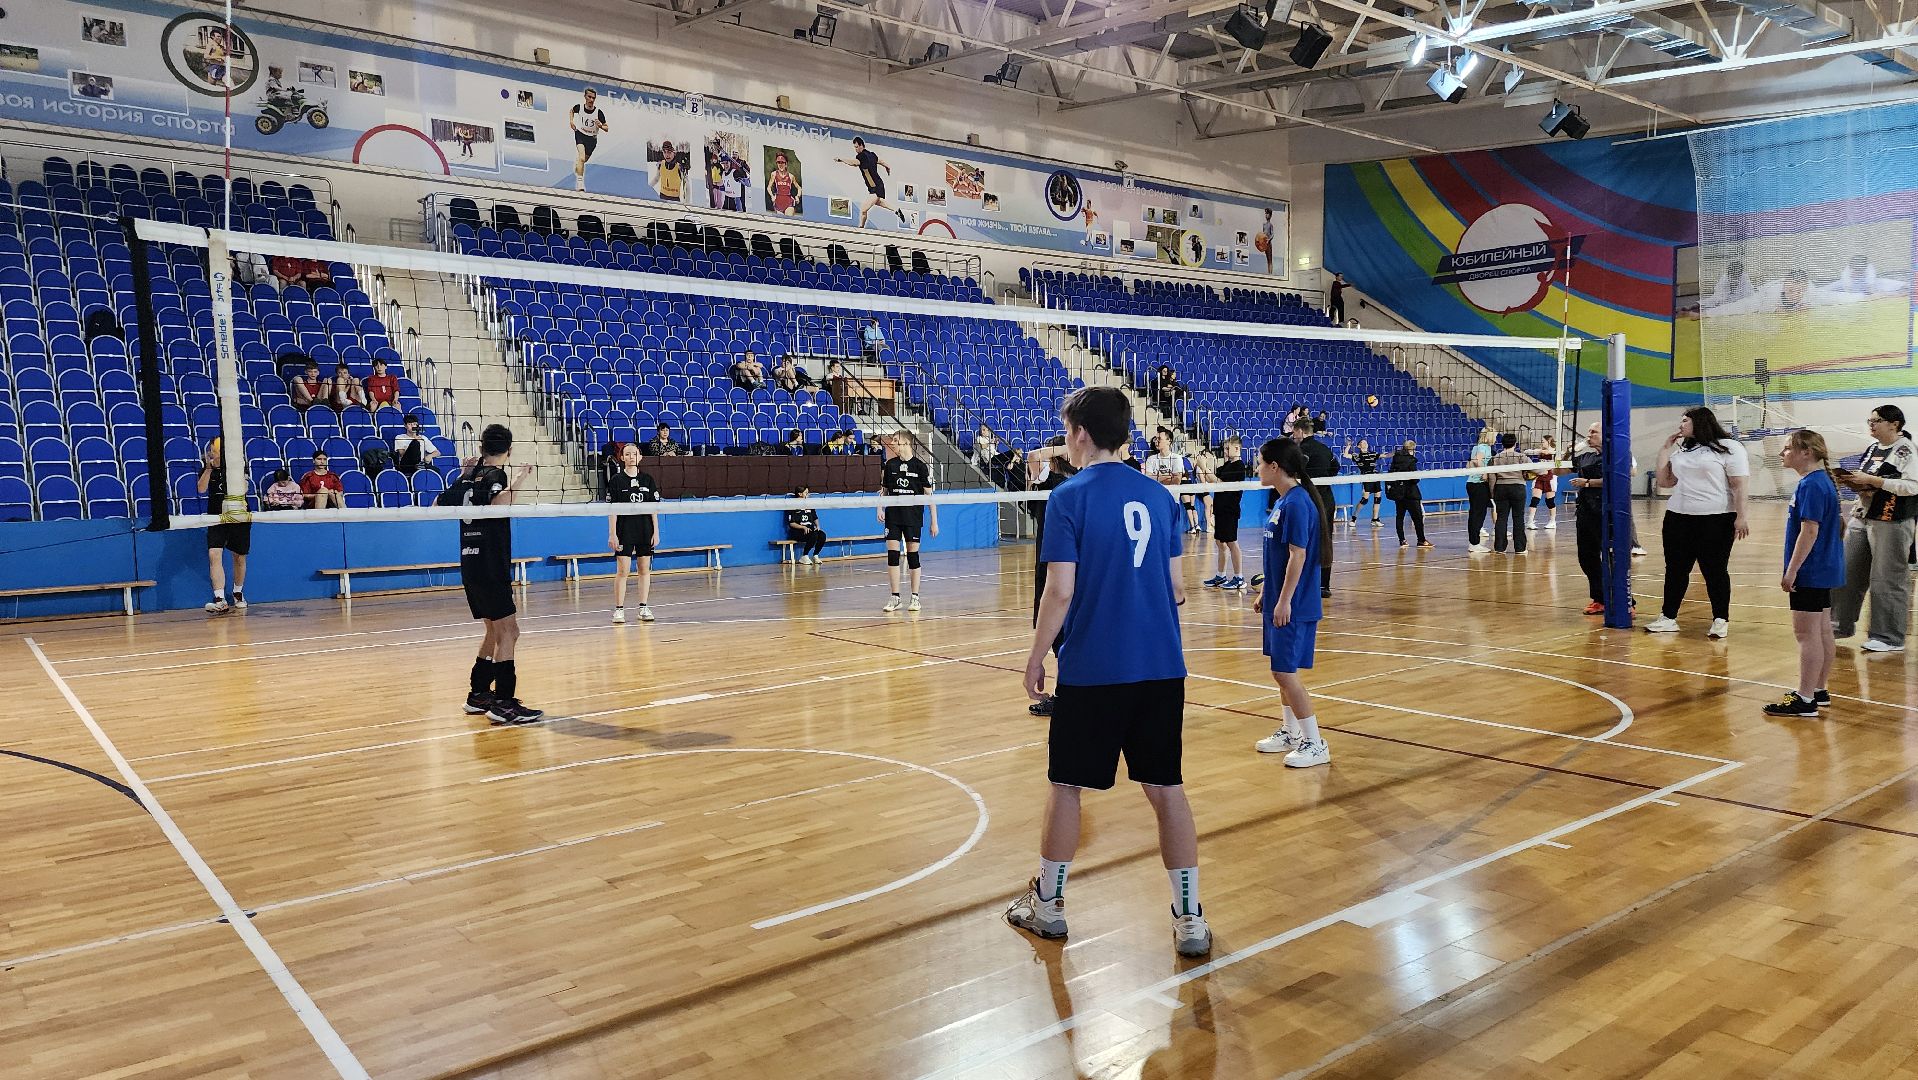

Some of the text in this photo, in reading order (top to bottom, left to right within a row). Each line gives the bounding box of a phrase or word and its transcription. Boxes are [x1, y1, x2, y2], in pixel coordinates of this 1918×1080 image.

[42, 98, 144, 123] история
[152, 113, 236, 135] спорта
[1452, 243, 1547, 267] ЮБИЛЕЙНЫЙ
[1469, 266, 1532, 281] ДВОРЕЦ СПОРТА
[1123, 501, 1152, 568] 9
